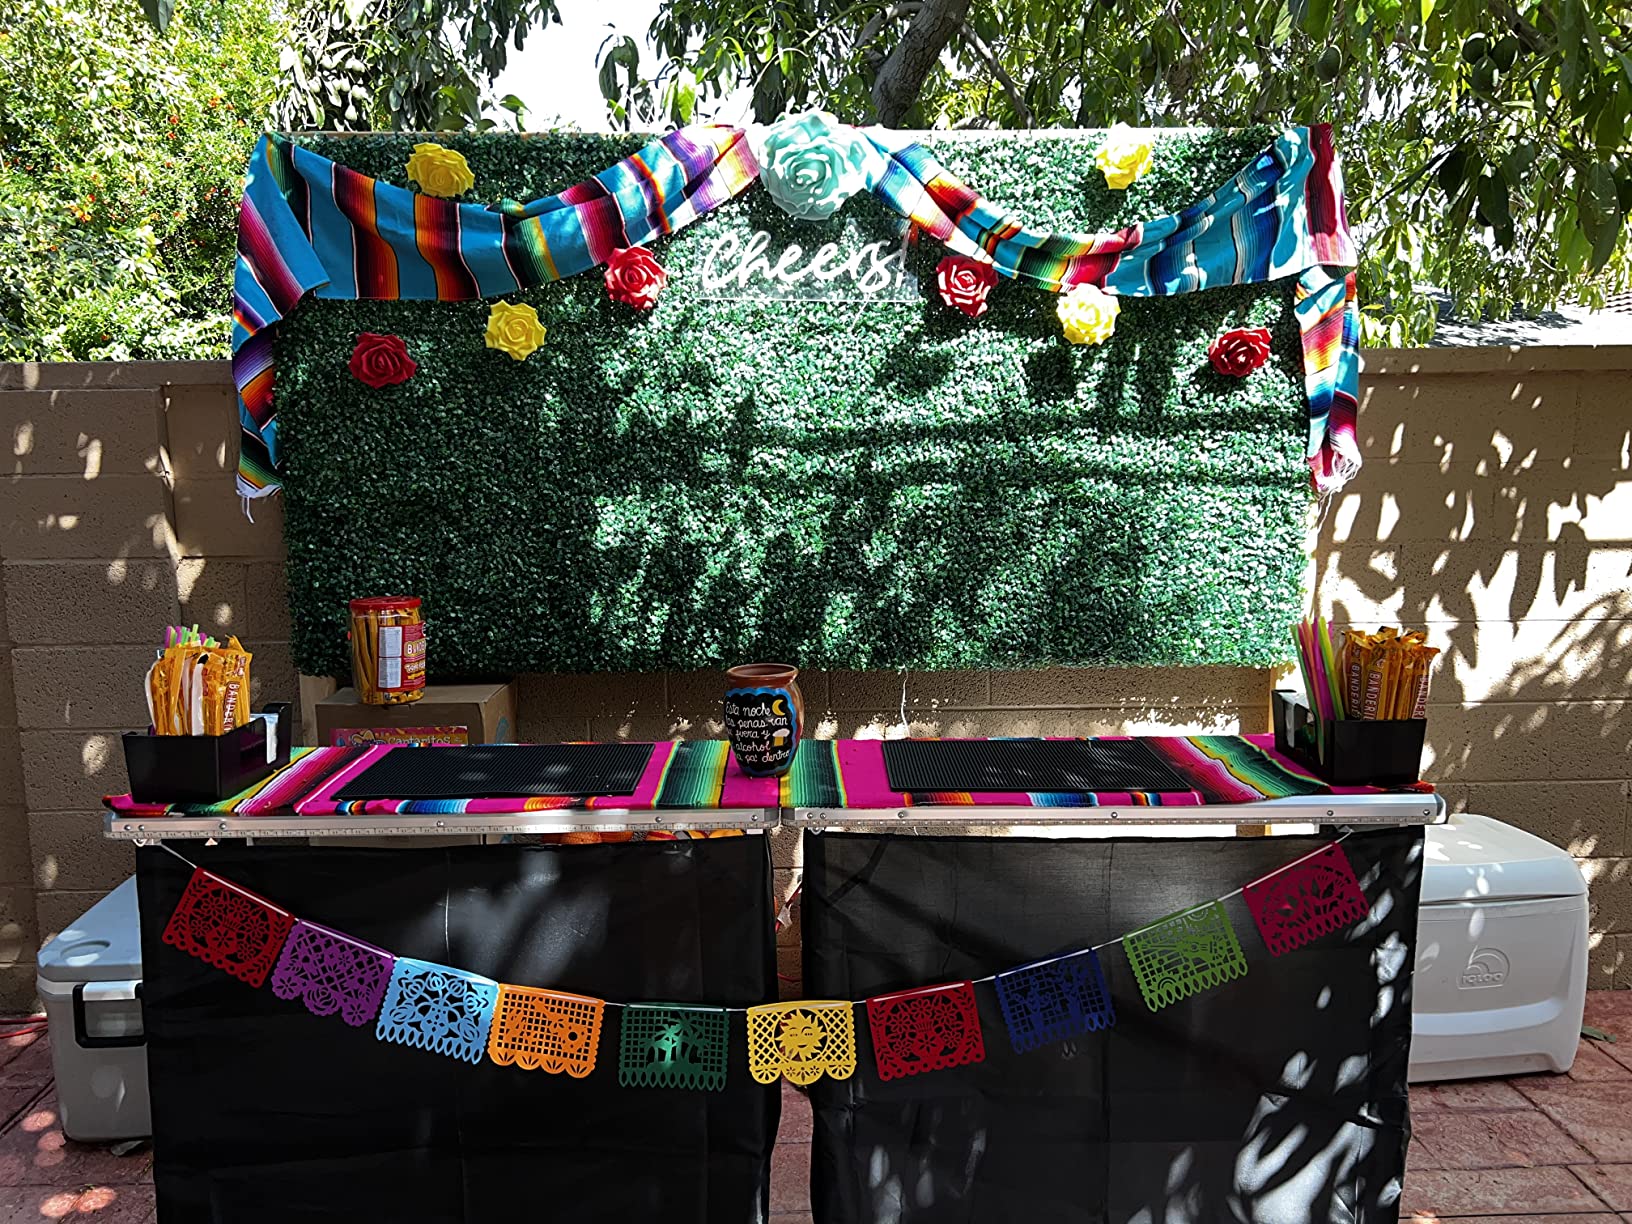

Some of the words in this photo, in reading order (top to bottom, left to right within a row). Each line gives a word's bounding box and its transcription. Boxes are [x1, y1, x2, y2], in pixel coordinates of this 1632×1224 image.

[742, 702, 771, 717] noche
[737, 719, 768, 729] penas
[735, 730, 760, 741] fuera
[760, 729, 771, 740] y
[735, 740, 770, 752] alcohol
[761, 750, 790, 763] dentro
